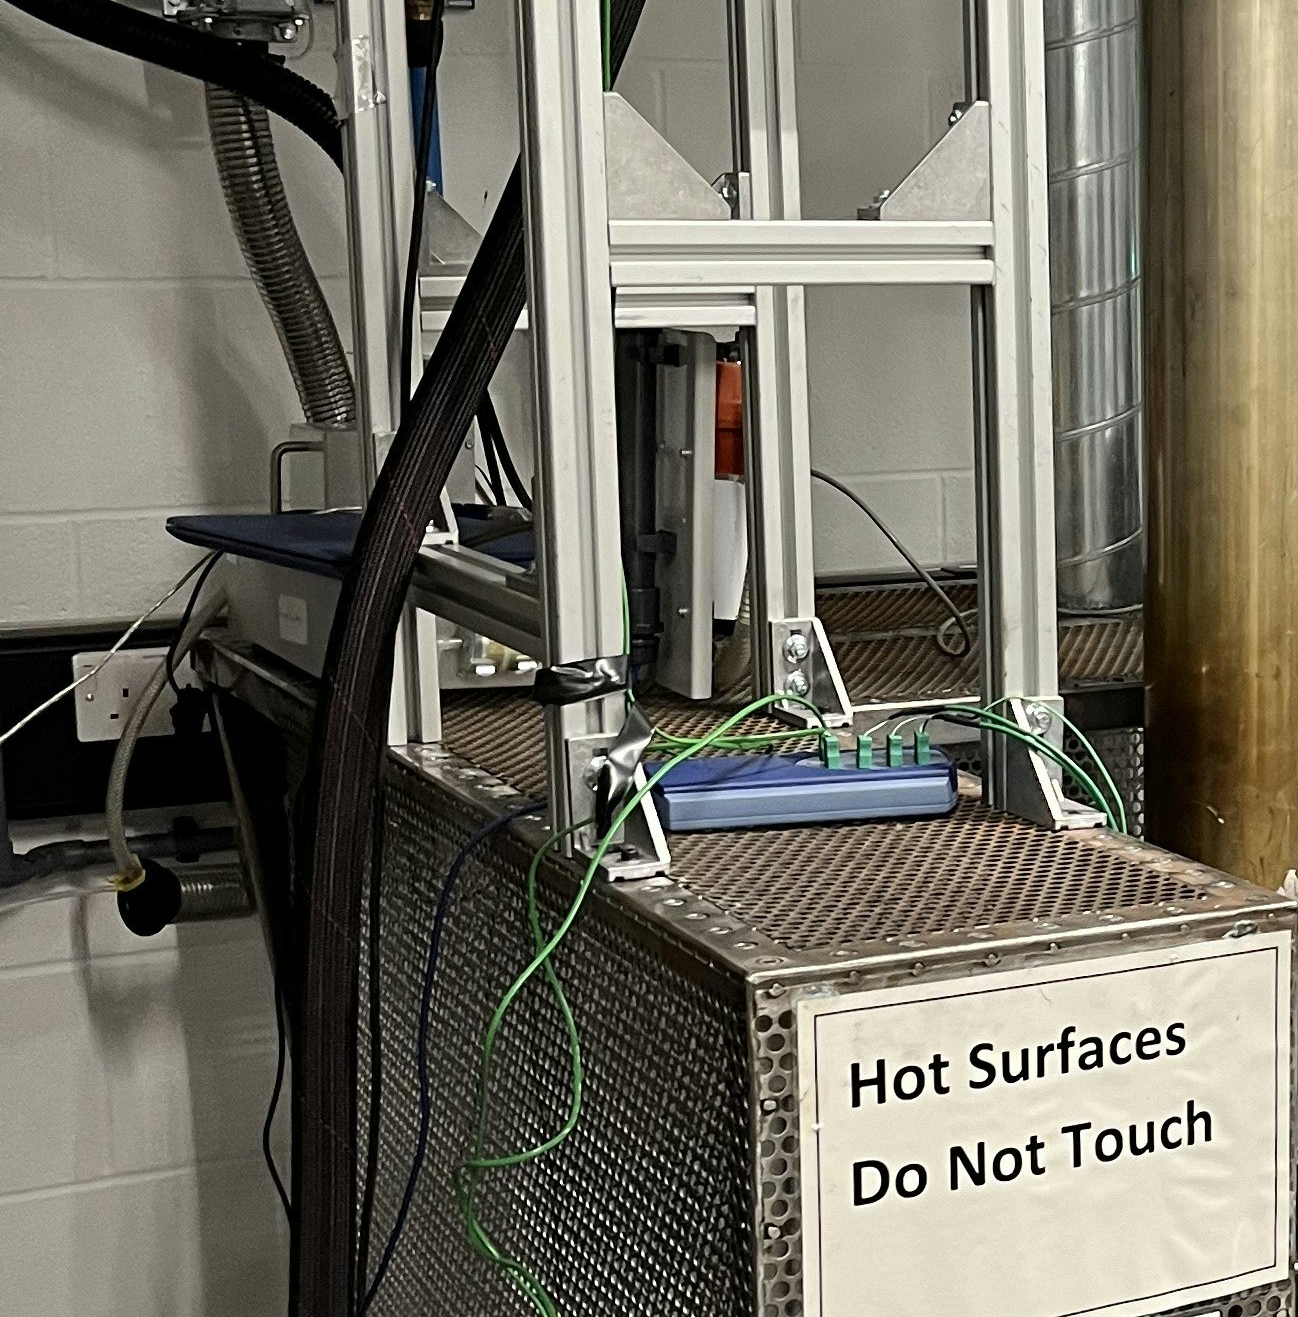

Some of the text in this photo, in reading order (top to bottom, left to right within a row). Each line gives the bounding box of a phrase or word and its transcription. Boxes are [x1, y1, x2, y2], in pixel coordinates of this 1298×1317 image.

[850, 1022, 1186, 1108] Hot Surfaces
[852, 1099, 1212, 1206] Do Not Touch
